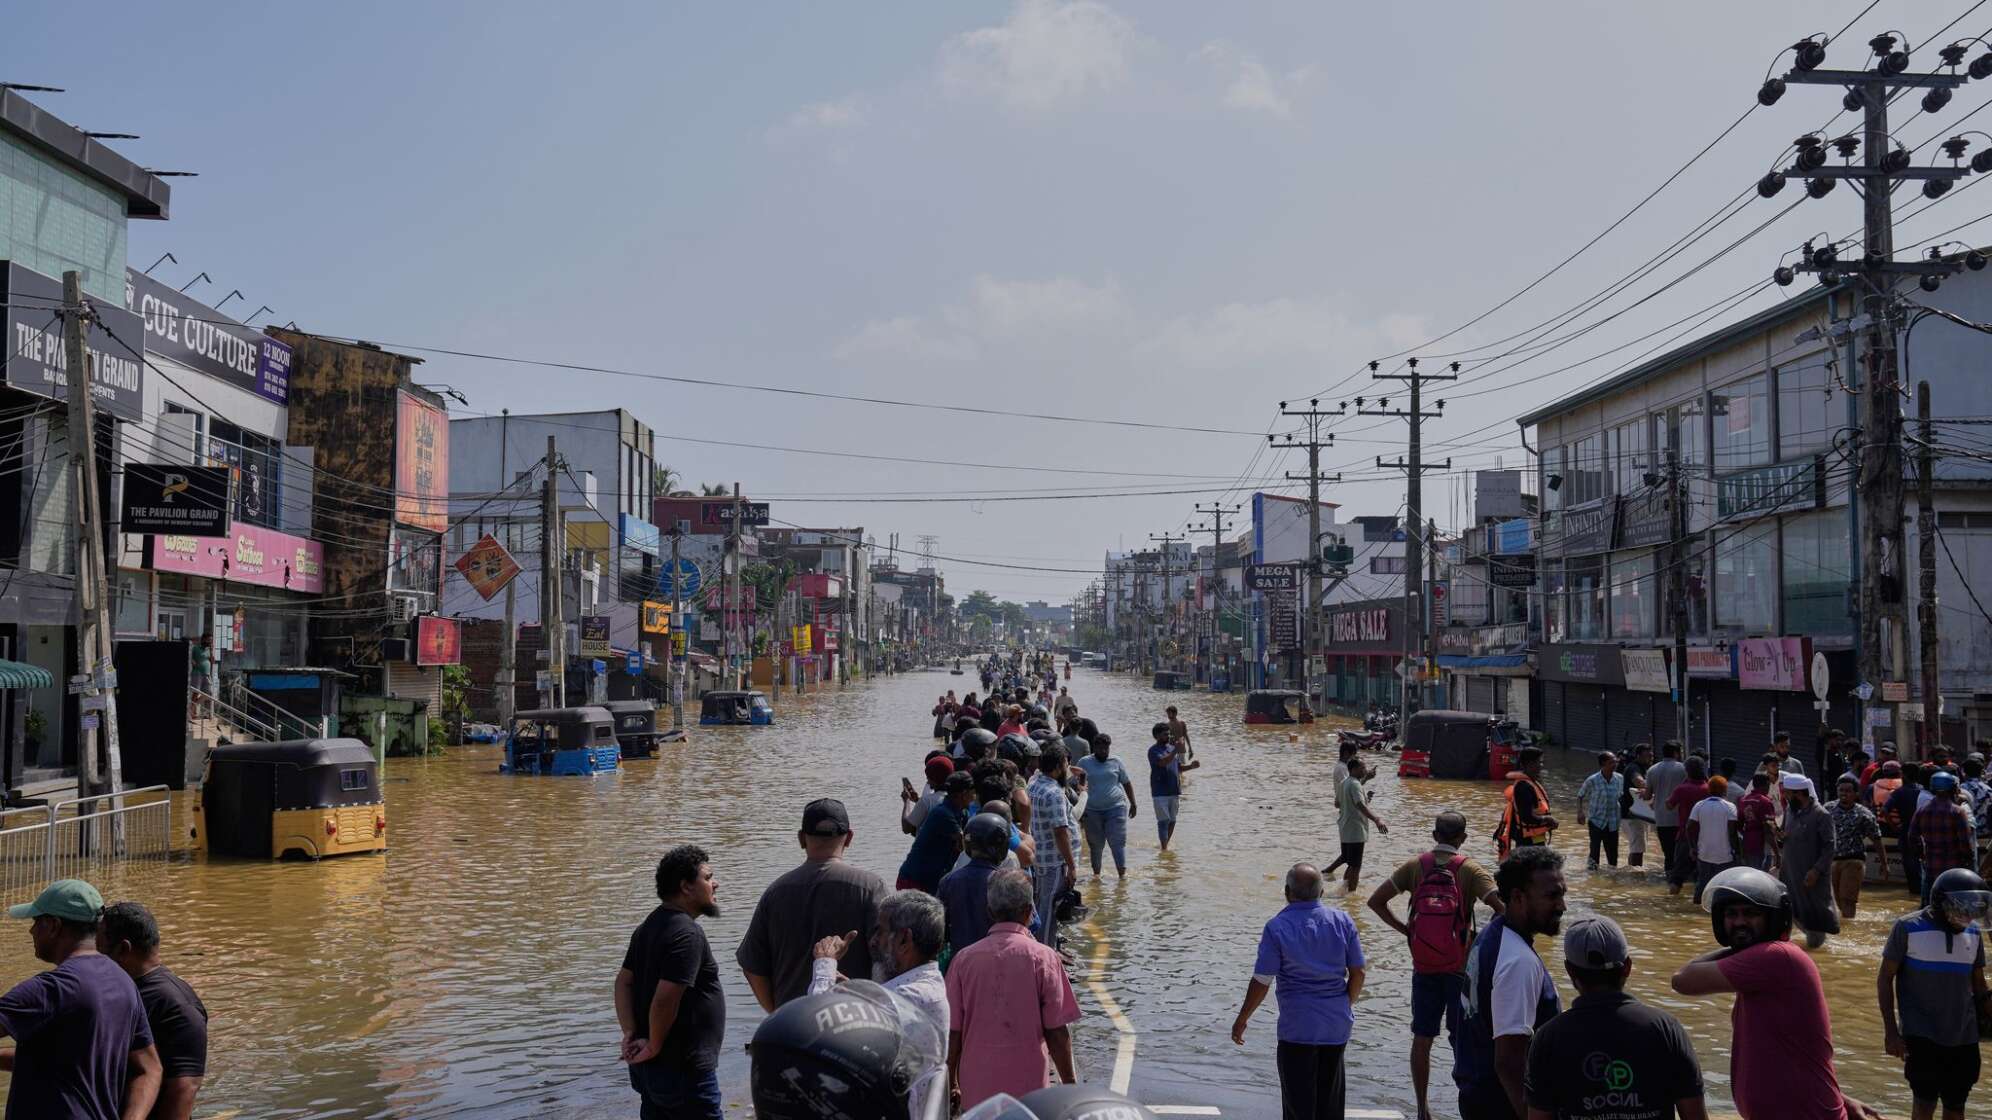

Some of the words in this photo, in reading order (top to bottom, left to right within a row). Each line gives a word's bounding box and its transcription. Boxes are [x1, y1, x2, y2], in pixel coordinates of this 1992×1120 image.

[141, 294, 178, 343] CUE
[184, 315, 257, 377] CULTURE
[16, 322, 42, 362] THE
[103, 352, 139, 392] GRAND
[263, 342, 271, 358] 12
[271, 345, 291, 367] NOON
[1725, 463, 1809, 514] MADAME
[130, 506, 147, 517] THE
[149, 507, 187, 519] PAVILION
[190, 509, 219, 520] GRAND
[1255, 566, 1292, 576] MEGA
[1256, 578, 1290, 588] SALE
[1332, 611, 1358, 641] MEGA
[1360, 609, 1387, 641] SALE
[582, 641, 608, 651] HOUSE
[1582, 1092, 1643, 1110] SOCIAL
